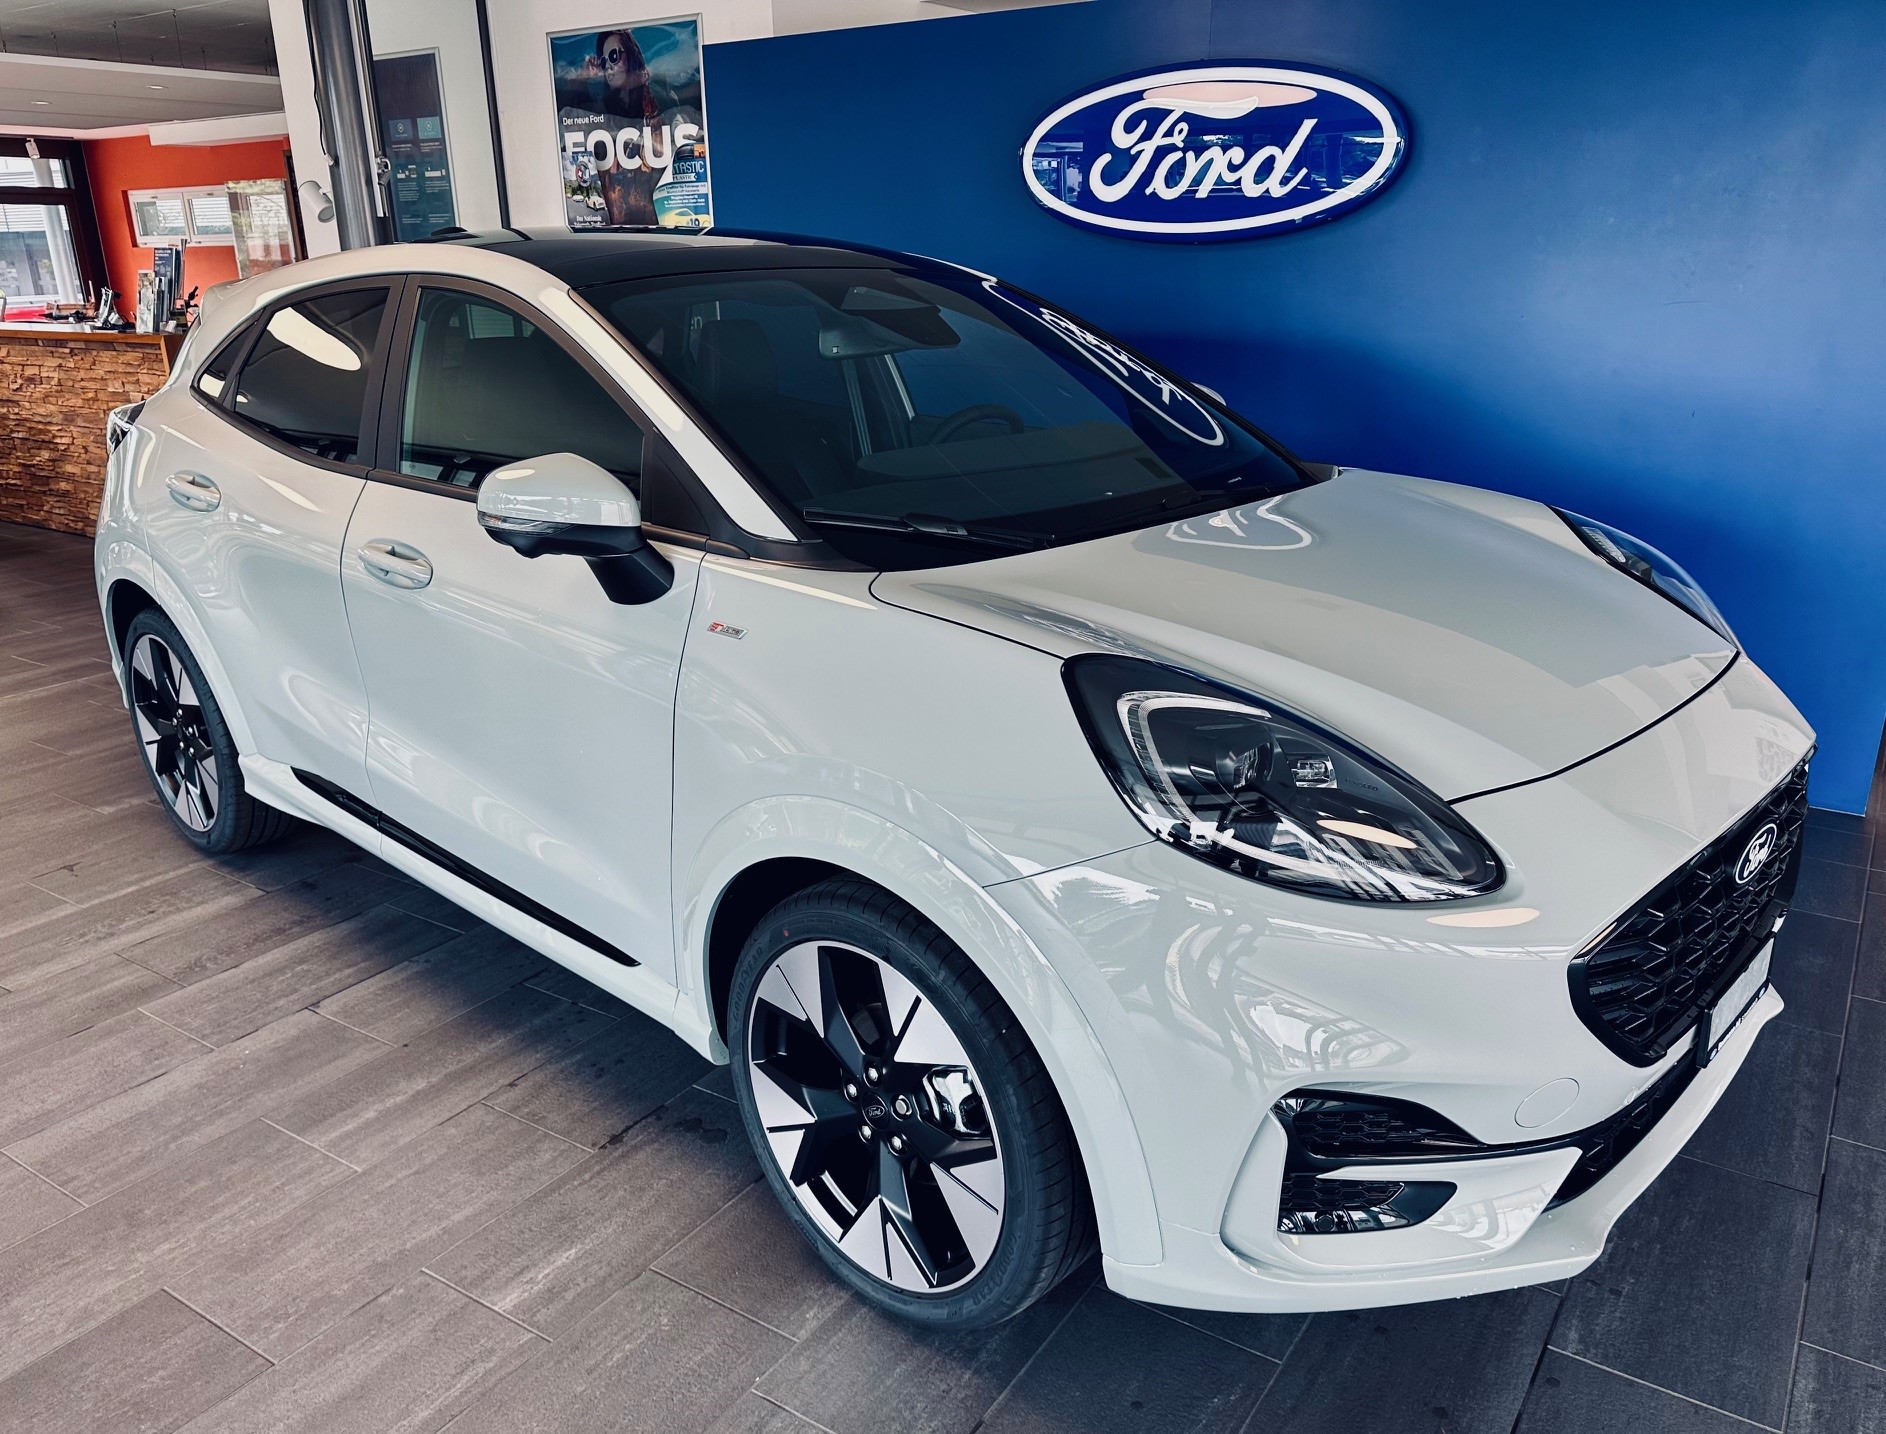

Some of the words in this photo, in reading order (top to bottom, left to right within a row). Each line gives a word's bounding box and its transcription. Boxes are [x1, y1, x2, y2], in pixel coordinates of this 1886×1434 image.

[563, 117, 573, 125] Der
[590, 114, 604, 123] Ford
[564, 123, 700, 171] FOCUS
[1089, 96, 1319, 203] Ford
[1742, 832, 1772, 878] Ford
